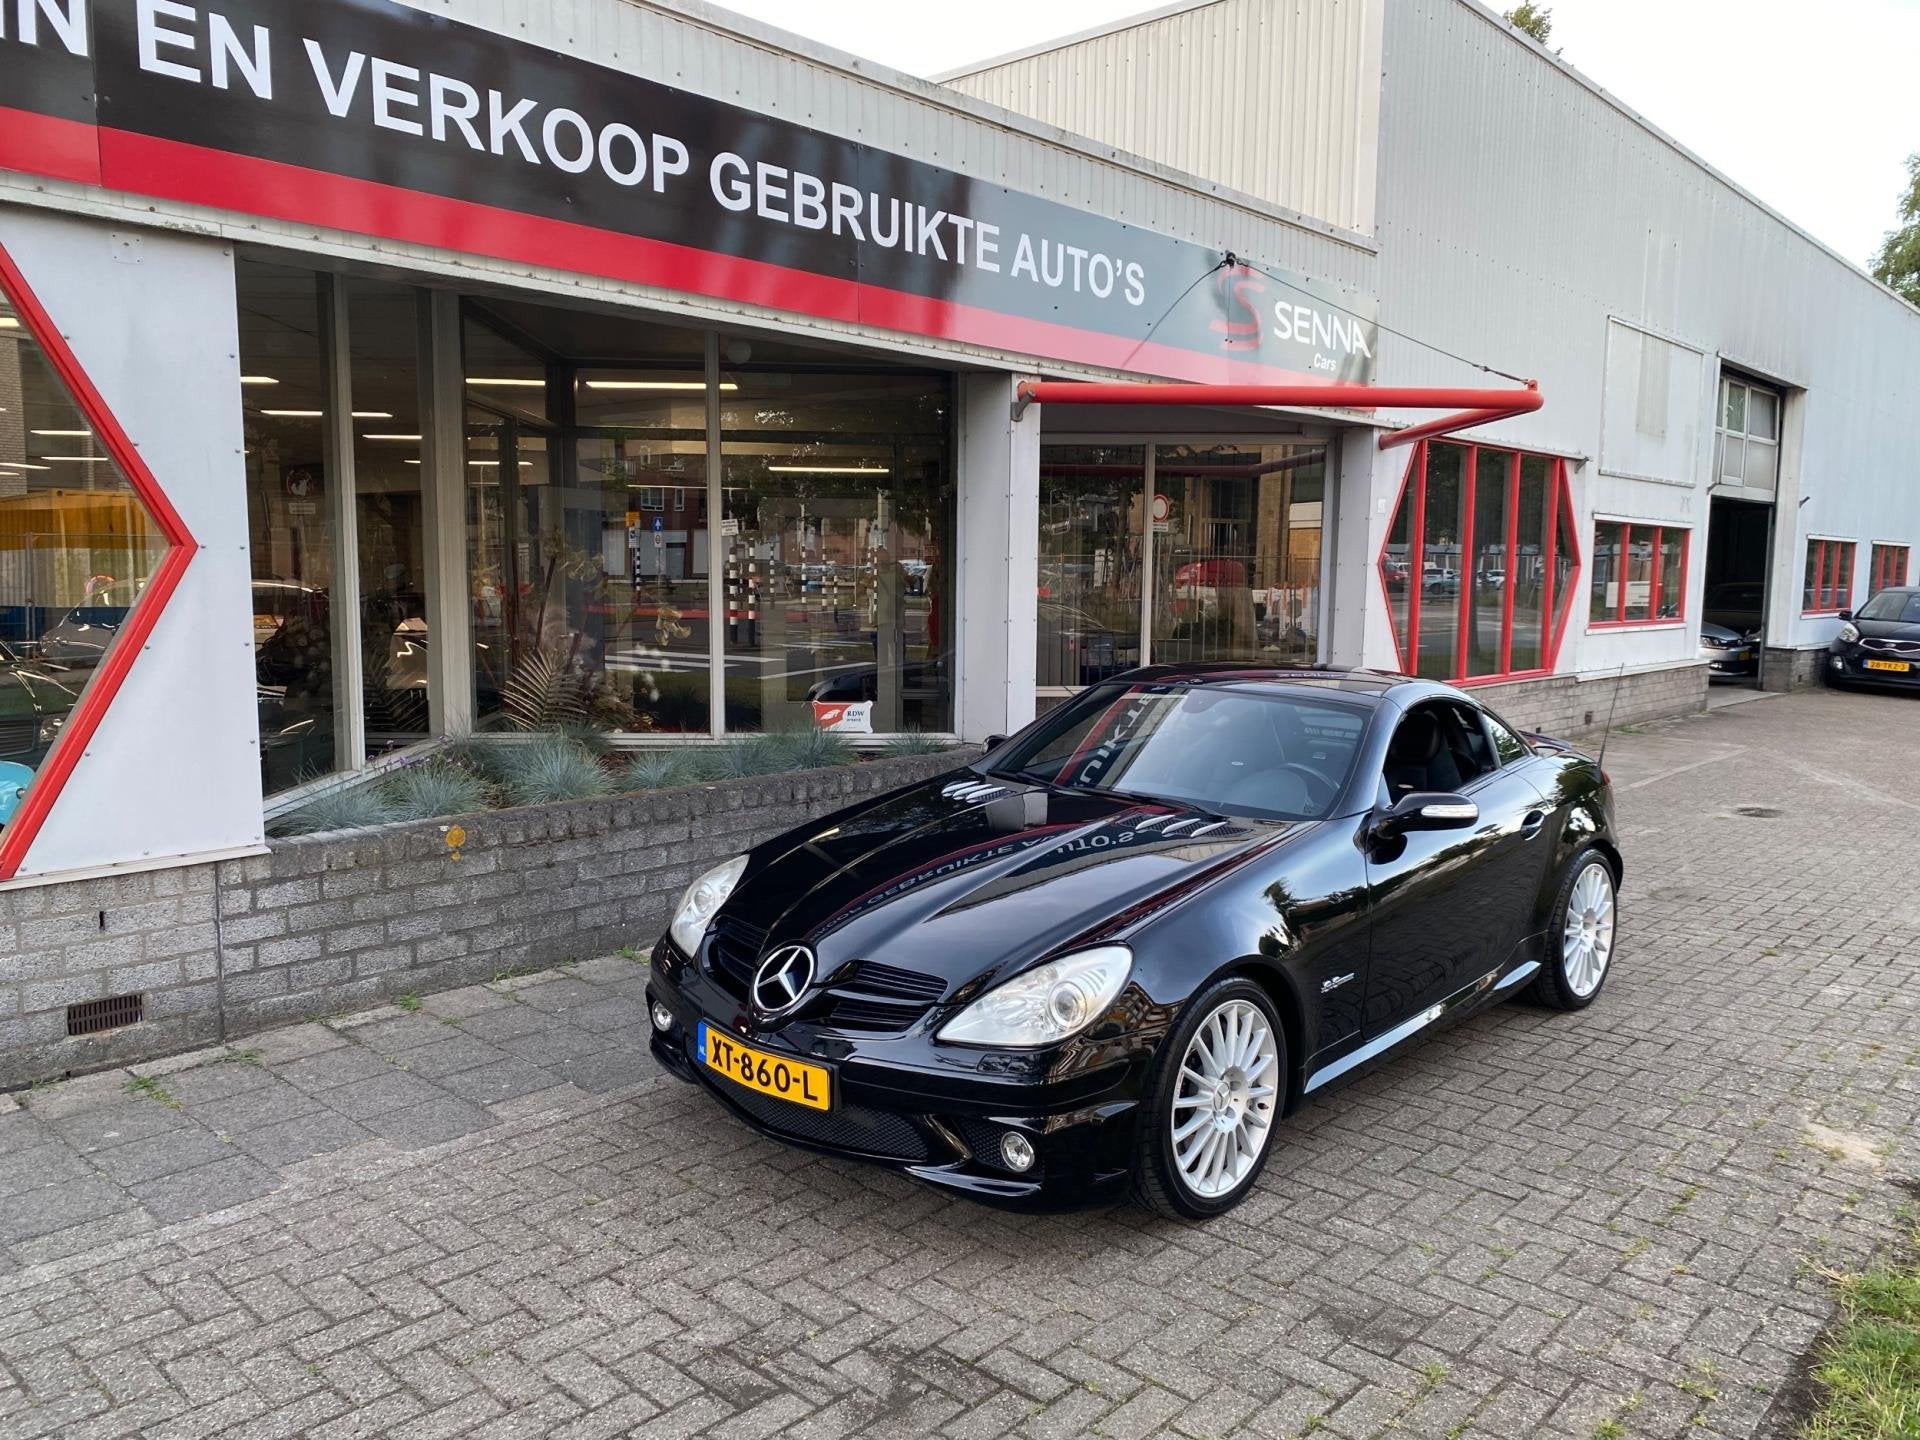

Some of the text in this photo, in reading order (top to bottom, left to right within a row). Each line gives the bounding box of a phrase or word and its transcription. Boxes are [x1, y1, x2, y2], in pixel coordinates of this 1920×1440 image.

[0, 0, 1146, 307] N EN VERKOOP GEBRUIKTE AUTO'S
[1273, 300, 1372, 358] SENNA
[1313, 353, 1337, 371] Cars
[711, 1035, 818, 1102] XT-860-L
